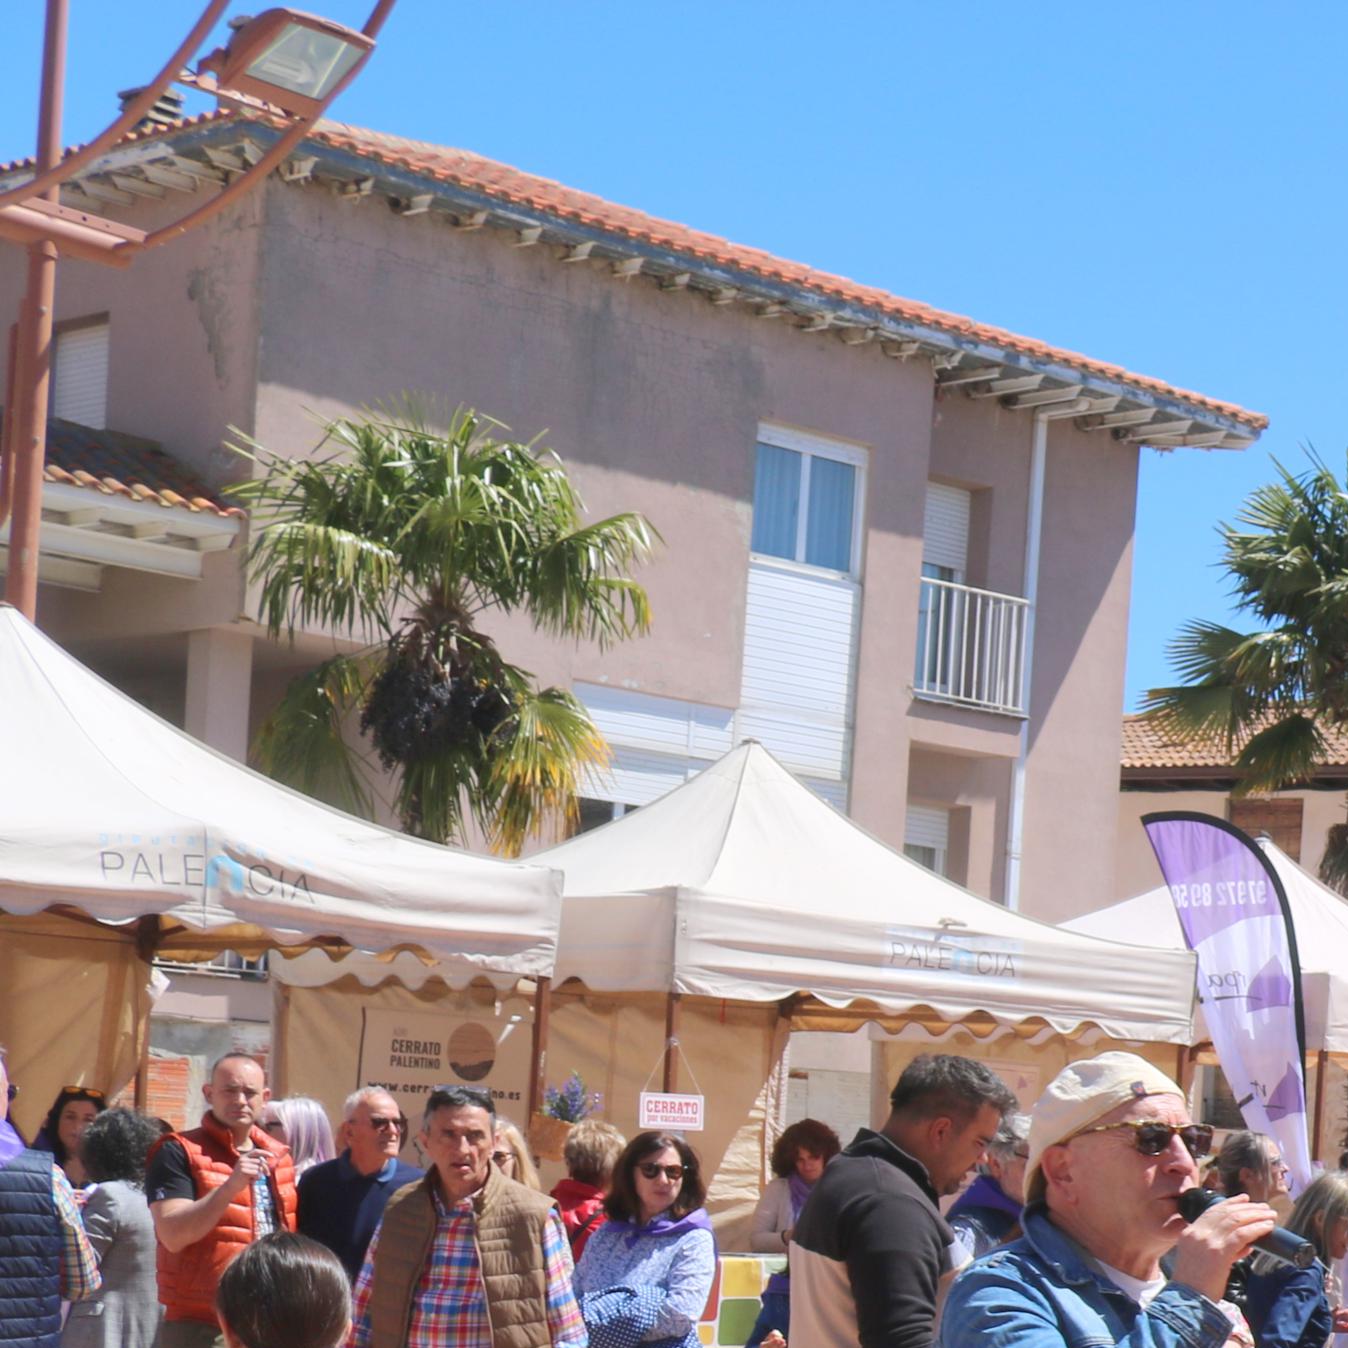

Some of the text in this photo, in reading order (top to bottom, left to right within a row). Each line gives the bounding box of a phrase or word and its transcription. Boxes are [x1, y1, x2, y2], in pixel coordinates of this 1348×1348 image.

[391, 1038, 441, 1056] CERRATO
[390, 1054, 441, 1070] PALENTINO
[646, 1099, 699, 1115] CERRATO
